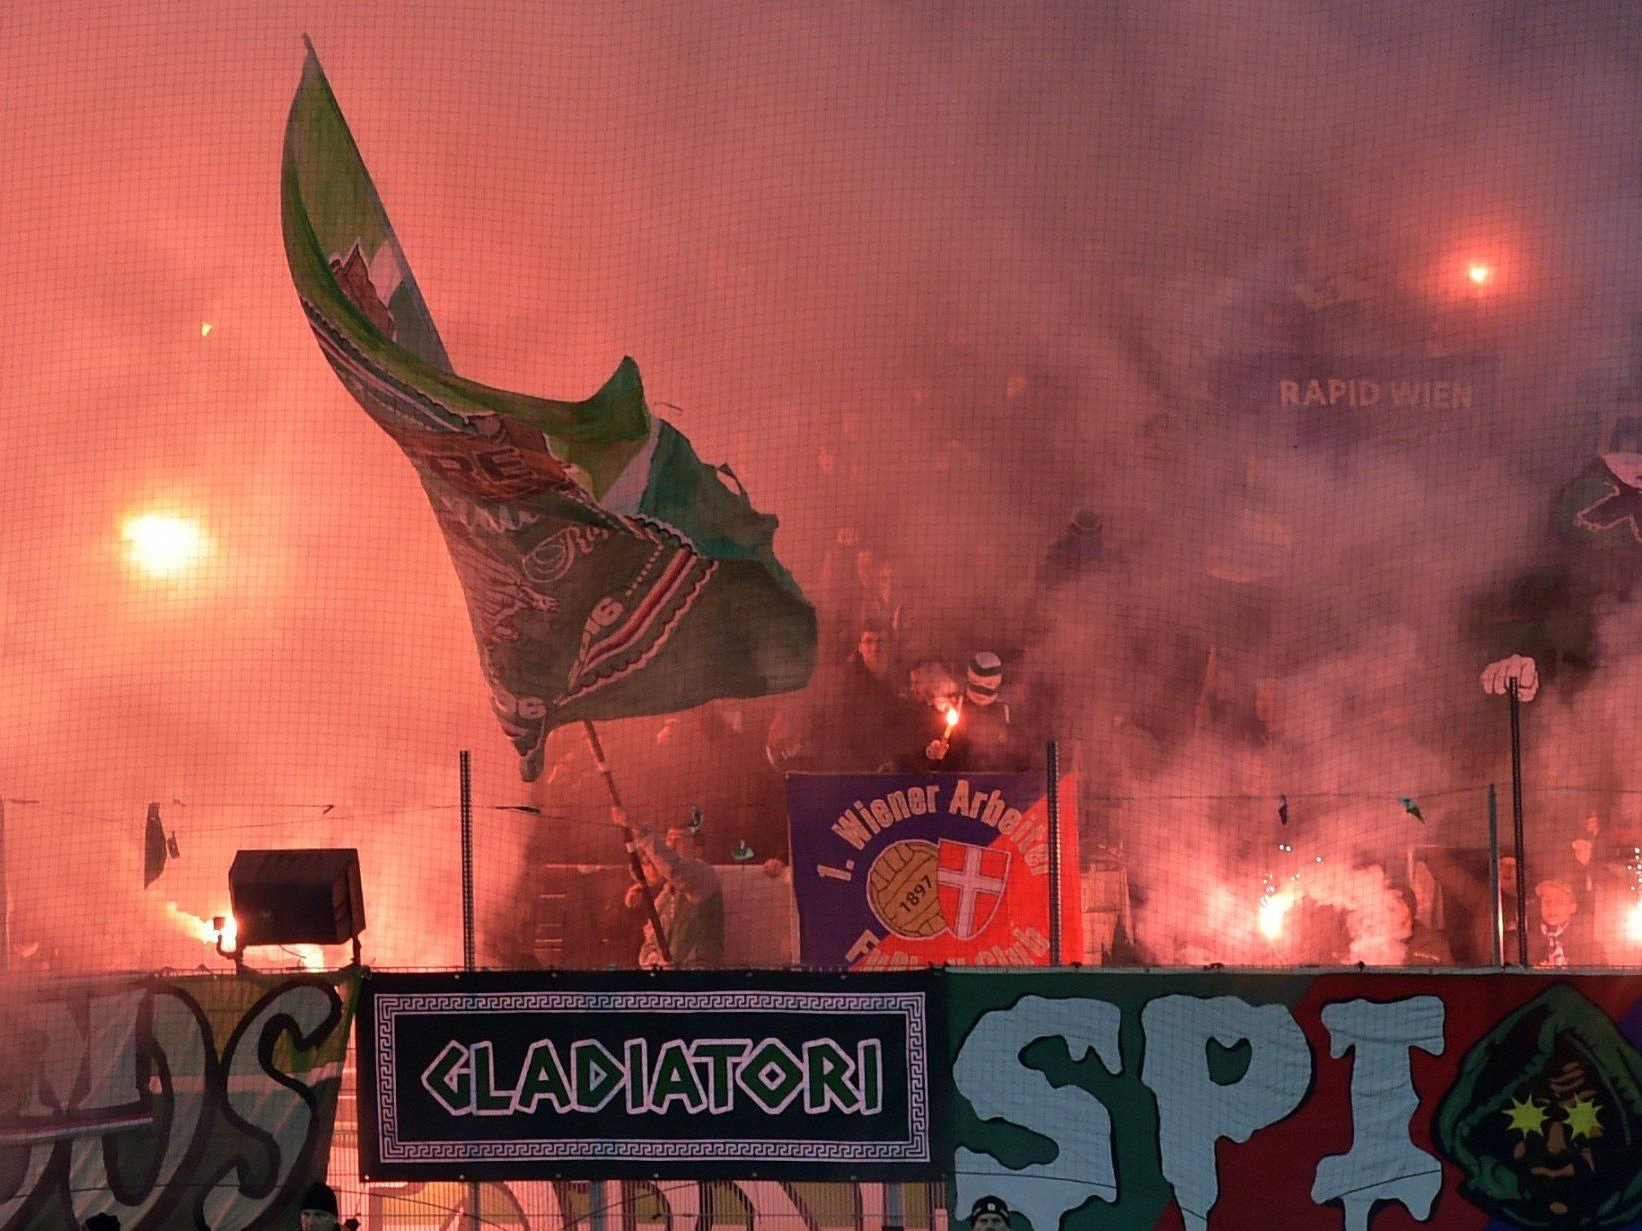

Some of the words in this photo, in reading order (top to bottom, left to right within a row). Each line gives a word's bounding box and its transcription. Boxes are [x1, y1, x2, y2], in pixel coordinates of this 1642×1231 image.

[1279, 378, 1381, 408] RAPID
[1391, 379, 1473, 409] WIEN
[831, 783, 940, 851] Wiener
[948, 779, 1050, 877] Arbeiter
[899, 874, 934, 913] 1897
[421, 1036, 885, 1115] GLADIATORI
